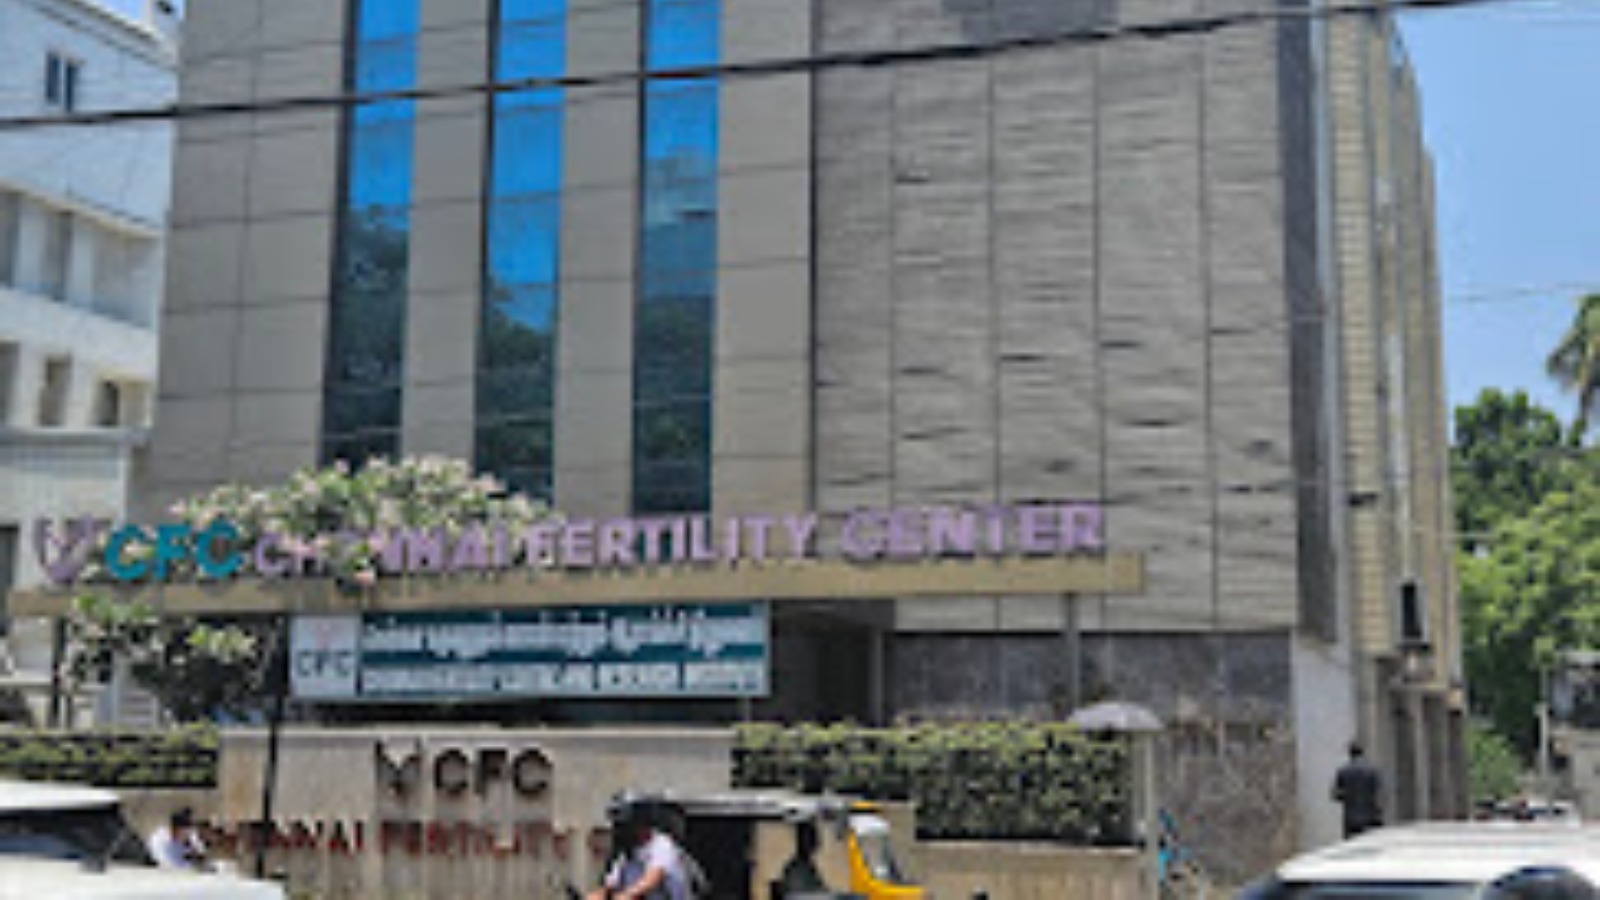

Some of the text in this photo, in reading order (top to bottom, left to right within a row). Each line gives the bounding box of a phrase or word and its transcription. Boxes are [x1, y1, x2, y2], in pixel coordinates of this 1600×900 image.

[107, 505, 1104, 580] CFC CHNNAI FERTILITY CENTER
[298, 652, 357, 678] CFC
[433, 747, 553, 798] CFC
